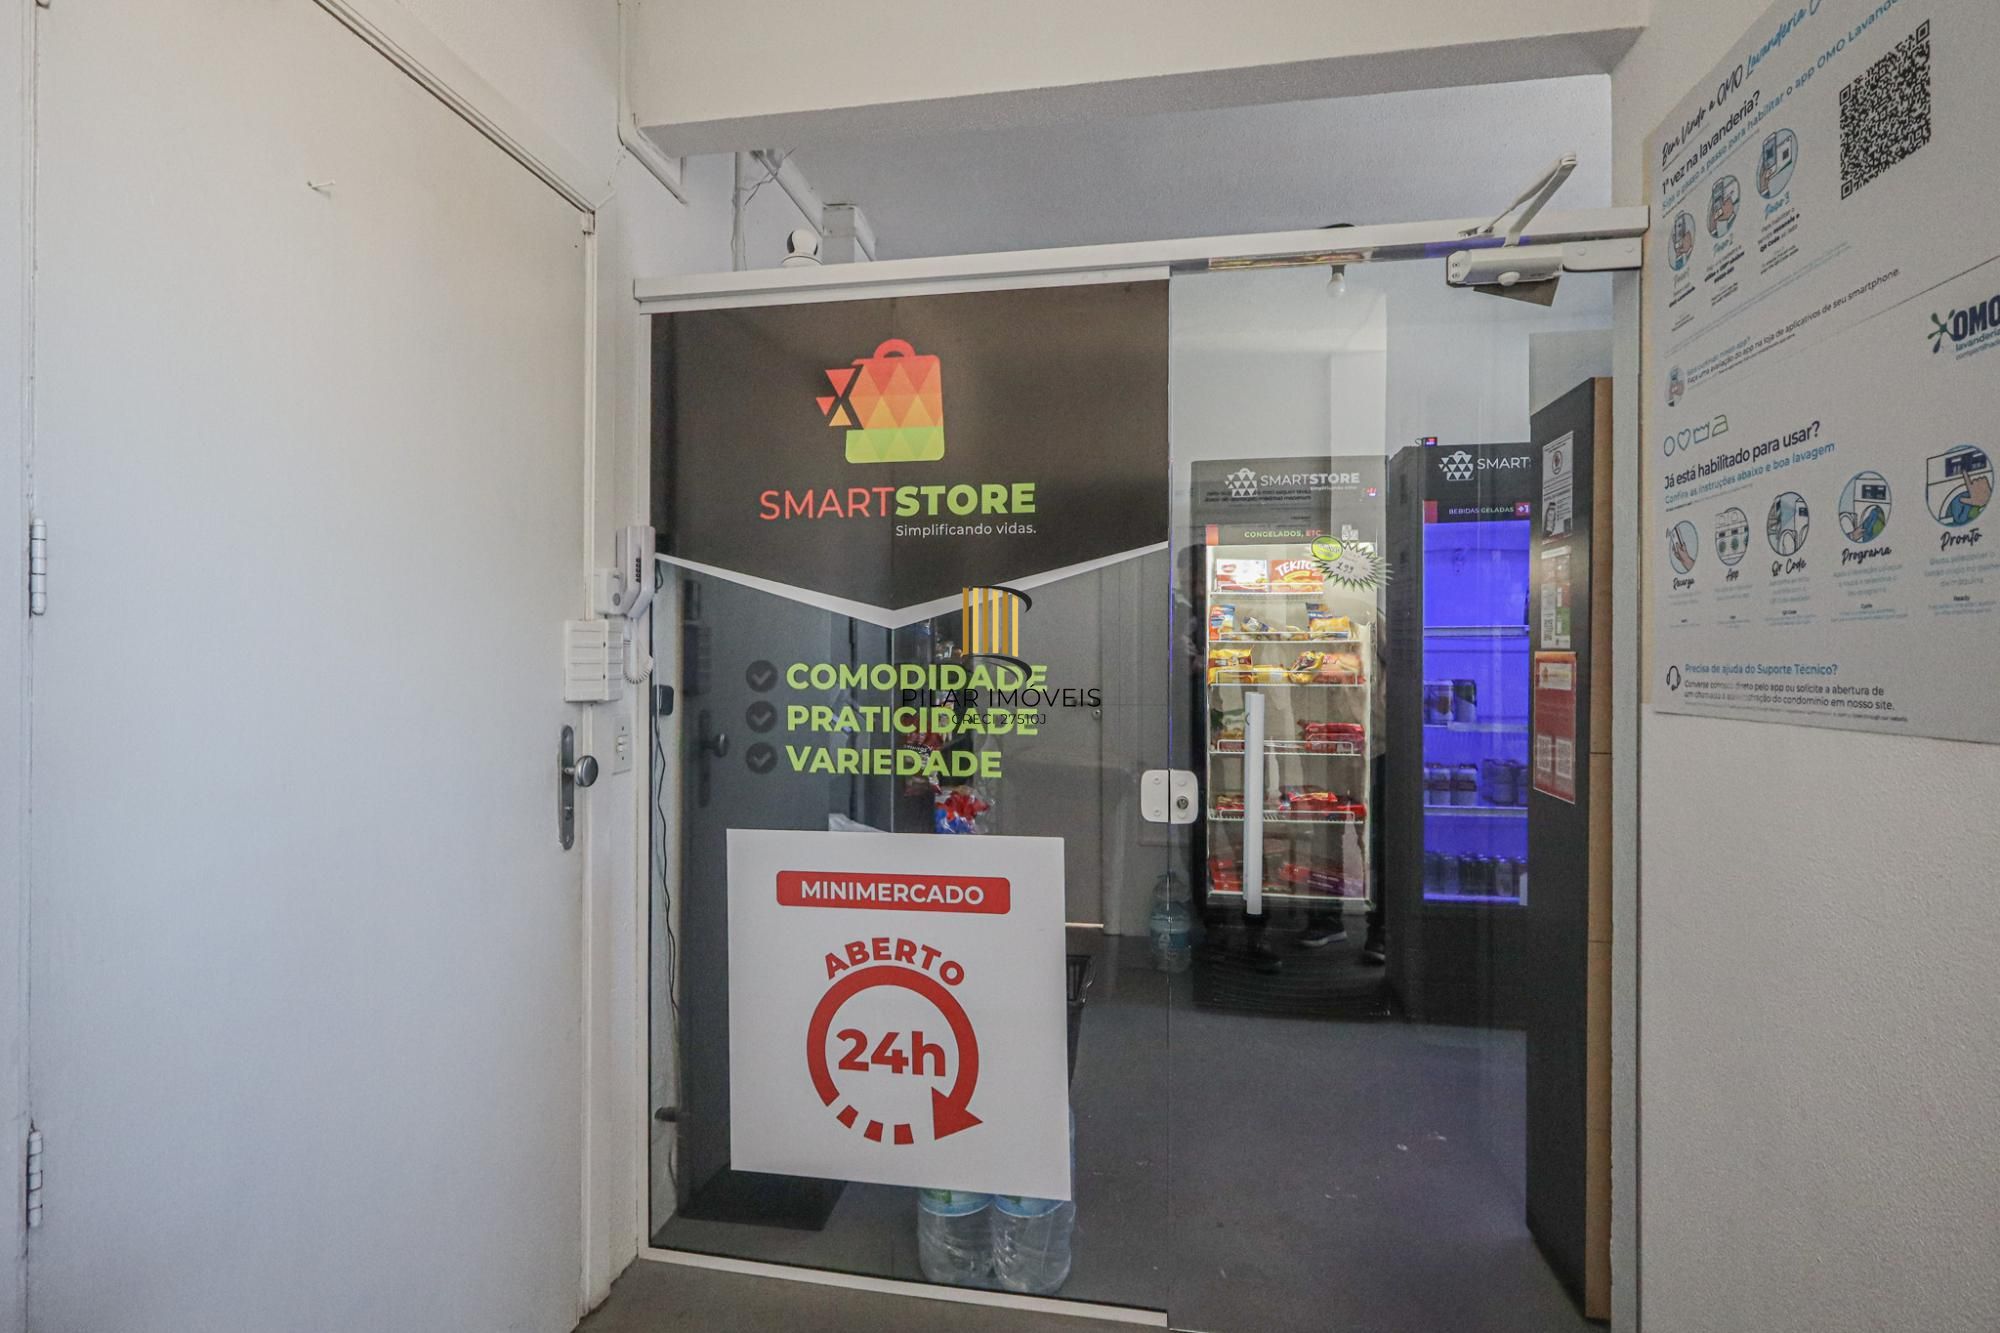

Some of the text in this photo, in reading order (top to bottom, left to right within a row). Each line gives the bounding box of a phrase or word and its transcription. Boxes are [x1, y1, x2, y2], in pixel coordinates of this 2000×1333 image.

[1747, 92, 1784, 131] habilitar
[1787, 86, 1792, 96] o
[1795, 67, 1815, 88] app
[1817, 38, 1846, 68] OMO
[1670, 166, 1686, 187] vez
[1686, 154, 1698, 172] na
[1699, 90, 1761, 159] lavanderia?
[1775, 327, 1784, 338] de
[1785, 308, 1821, 335] aplicativos
[1822, 302, 1832, 314] de
[1832, 295, 1847, 308] seu
[1951, 294, 2000, 342] OMO
[1477, 456, 1532, 470] SMART
[1664, 420, 1821, 490] Já está habilitado para usar?
[1736, 466, 1764, 481] abaixo
[1773, 457, 1790, 470] boa
[1791, 442, 1836, 464] lavagem
[1260, 472, 1361, 486] SMARTSTORE
[759, 482, 1036, 521] SMARTSTORE
[895, 521, 1037, 539] Simplificando vidas.
[1940, 527, 1983, 551] Pronto
[1275, 559, 1317, 576] TEKITO
[1841, 546, 1893, 566] Programa
[785, 662, 1048, 692] COMODIDADE
[1711, 663, 1721, 673] de
[1722, 663, 1743, 676] ajuda
[1744, 663, 1756, 674] do
[1757, 663, 1792, 676] Suporte
[1794, 663, 1838, 676] Técnico?
[1754, 682, 1769, 692] pelo
[1770, 684, 1784, 692] app
[1785, 684, 1795, 693] ou
[1796, 683, 1823, 694] solicite
[1832, 684, 1870, 696] abertura
[1872, 685, 1885, 696] de
[1783, 694, 1829, 706] condomínio
[1830, 697, 1845, 707] em
[1846, 699, 1874, 709] nosso
[1875, 700, 1896, 711] site.
[786, 704, 1039, 735] PRATICIDADE
[785, 745, 1002, 778] VARIEDADE
[801, 880, 985, 905] MINIMERCADO
[824, 937, 965, 986] ABERTO
[836, 1028, 947, 1077] 24h
